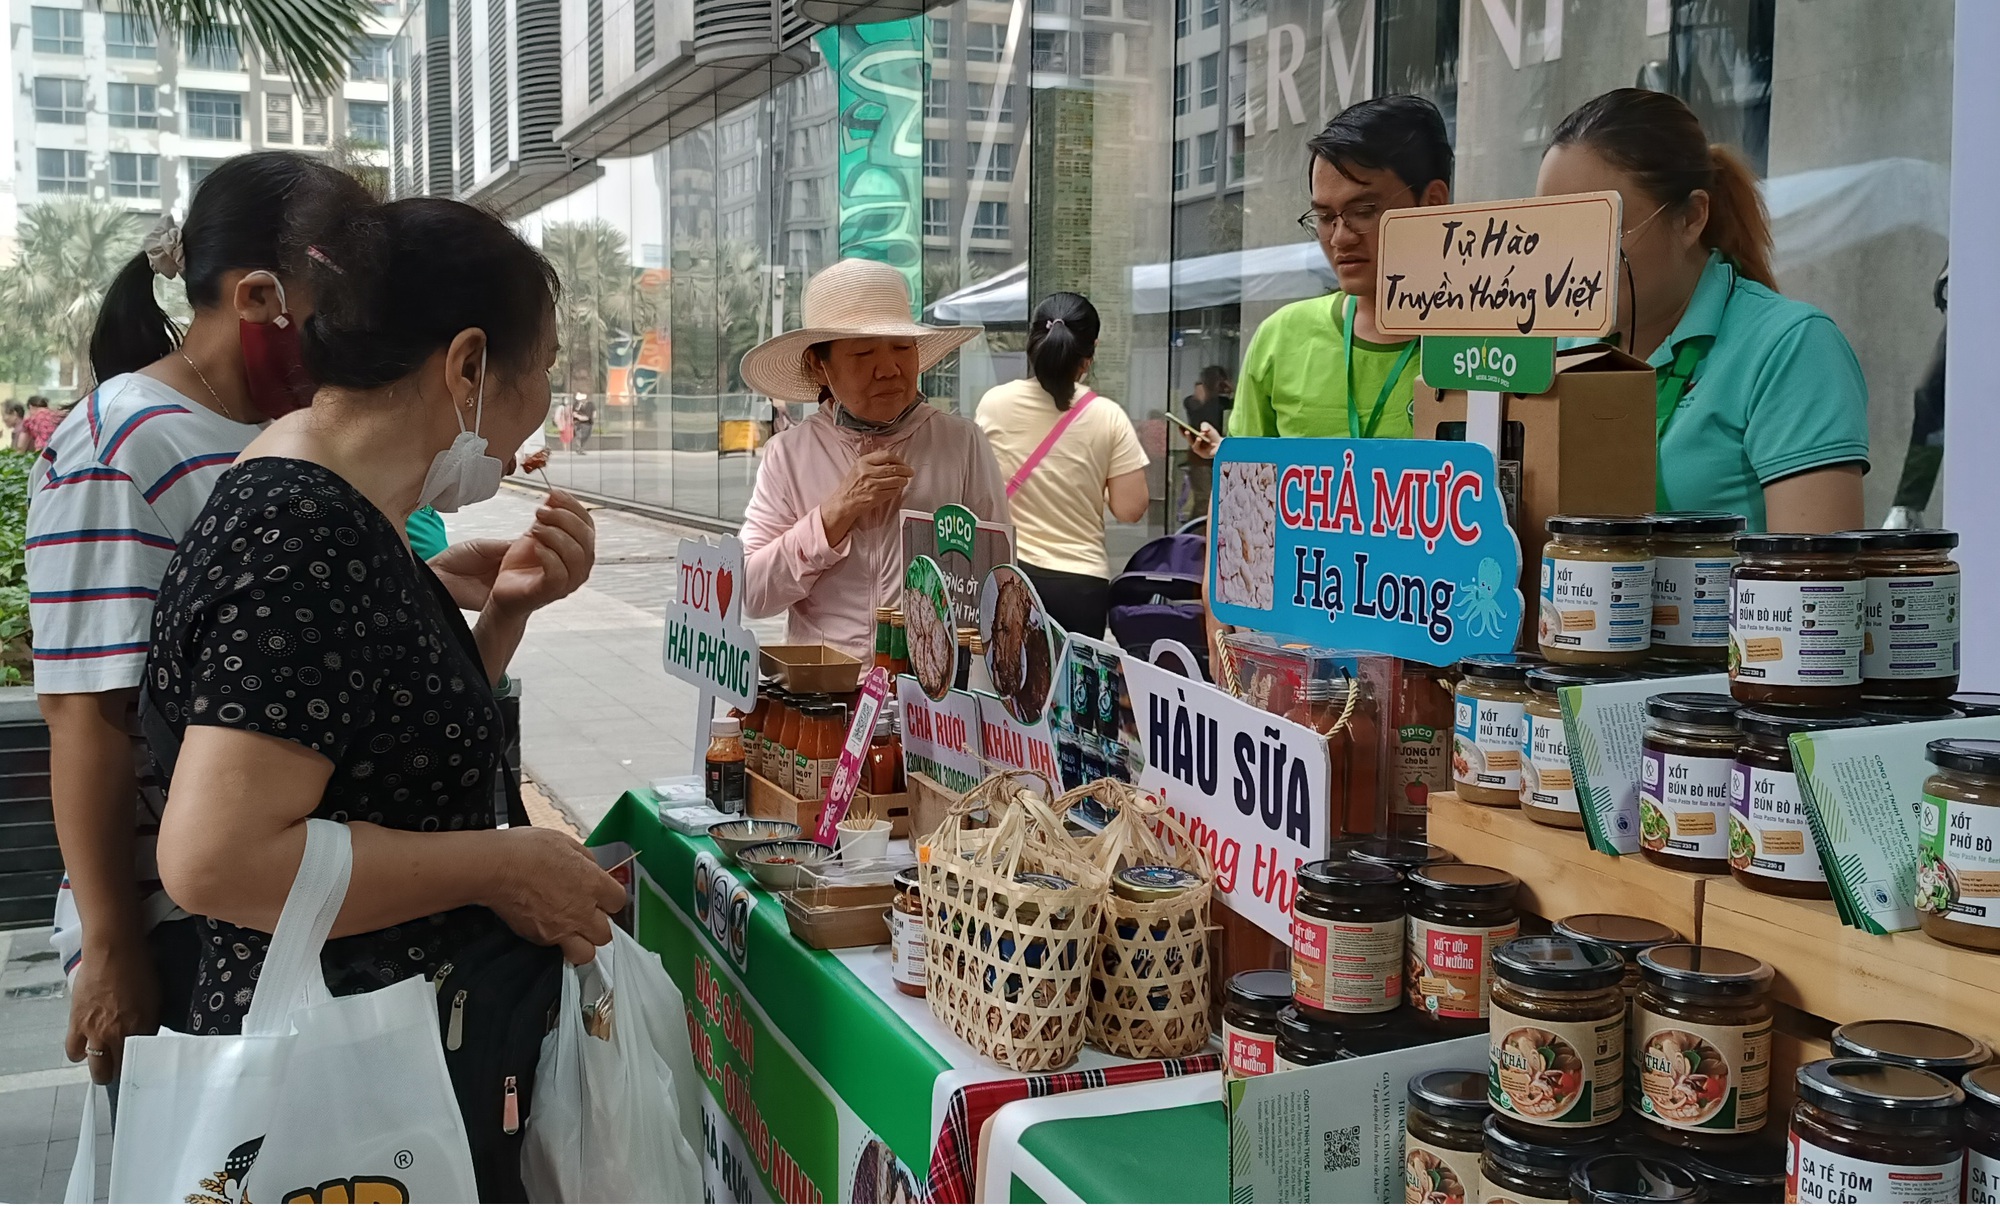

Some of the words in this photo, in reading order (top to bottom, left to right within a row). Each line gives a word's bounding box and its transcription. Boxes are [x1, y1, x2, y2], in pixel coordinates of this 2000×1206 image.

[1442, 220, 1477, 266] Tự
[1481, 217, 1540, 259] Hào
[1386, 272, 1464, 321] Truyền
[1469, 265, 1537, 334] thống
[1545, 257, 1603, 318] Việt
[1280, 450, 1363, 533] CHẢ
[1371, 462, 1482, 553] MỰC
[682, 557, 712, 613] TÔI
[1293, 546, 1344, 623] Hạ
[1353, 552, 1455, 644] Long
[668, 613, 694, 670] HẢI
[697, 628, 750, 697] PHÒNG
[907, 699, 932, 742] CHẢ
[1401, 727, 1432, 738] spico
[983, 719, 1024, 769] KHÂU
[1149, 687, 1218, 796] HÀU
[1233, 725, 1310, 848] SỮA
[1669, 764, 1688, 780] XỐT
[1669, 781, 1687, 795] BÚN
[1690, 783, 1703, 797] BÒ
[1707, 782, 1727, 798] HUẾ
[1754, 778, 1775, 795] XỐT
[1754, 796, 1773, 812] BÚN
[1776, 799, 1790, 814] BÒ
[1950, 811, 1972, 830] XỐT
[1949, 833, 1972, 850] PHỞ
[1976, 836, 1992, 852] BÒ
[694, 953, 721, 1027] ĐẶC
[723, 991, 755, 1075] SẢN
[1503, 1051, 1527, 1071] THÁI
[1645, 1052, 1671, 1074] THÁI
[723, 1062, 770, 1174] QUẢNG
[1801, 1177, 1823, 1200] CAO
[1802, 1157, 1815, 1176] SA
[1819, 1163, 1835, 1183] TẾ
[1839, 1171, 1873, 1192] TÔM
[1972, 1167, 1987, 1187] SA
[1991, 1175, 2000, 1190] T
